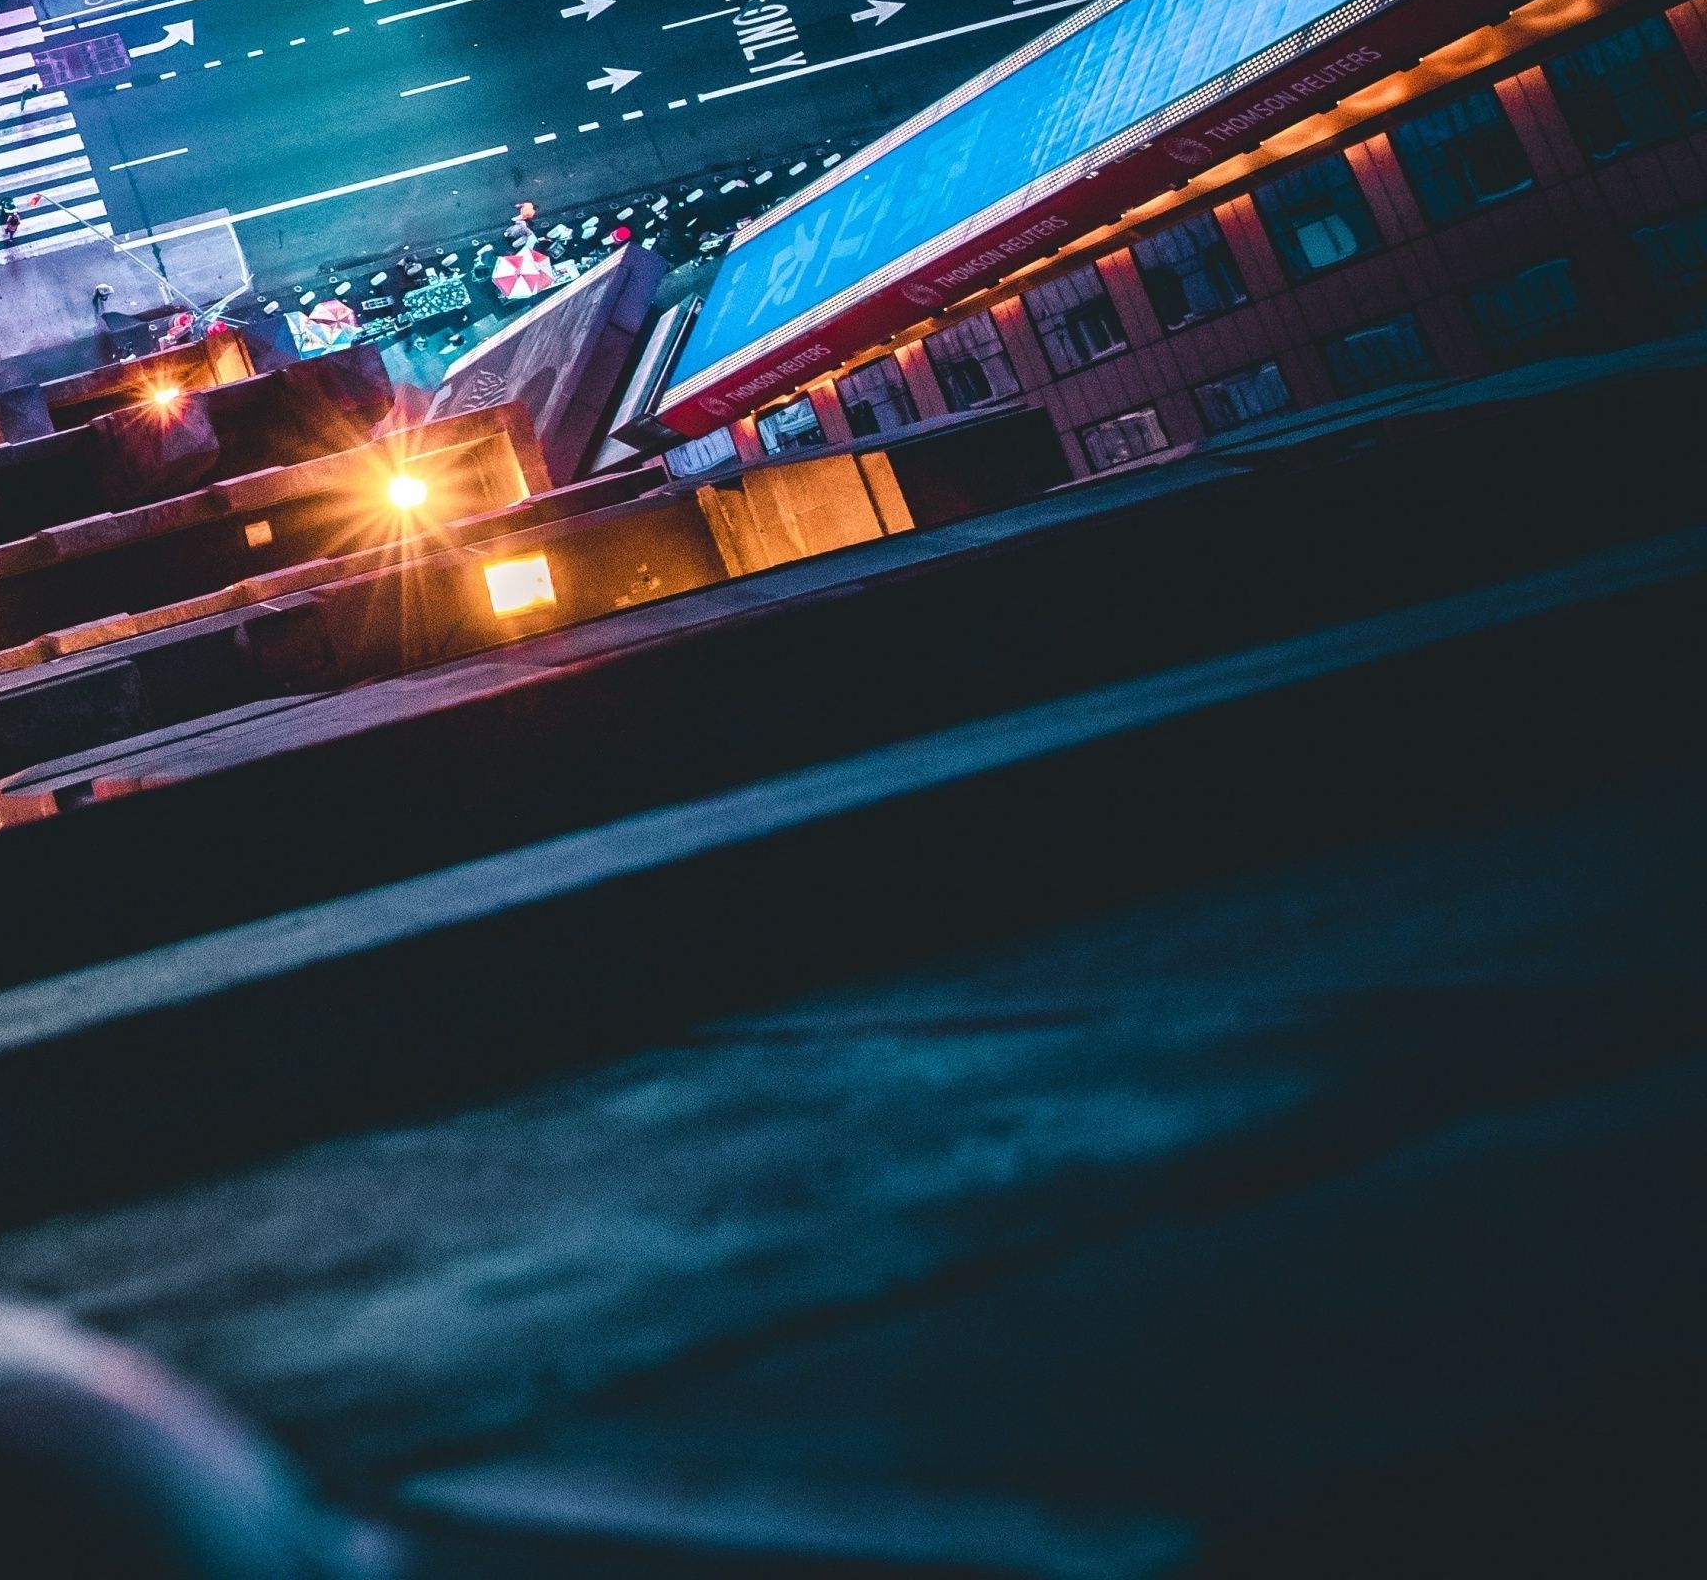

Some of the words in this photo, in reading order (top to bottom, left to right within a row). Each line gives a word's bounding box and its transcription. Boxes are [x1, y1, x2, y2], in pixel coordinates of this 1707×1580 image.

[732, 4, 807, 74] ONLY
[1204, 89, 1299, 140] THOMSON
[1292, 46, 1383, 96] REUTERS
[933, 249, 1007, 288] THOMSON
[998, 215, 1068, 254] REUTERS
[776, 343, 832, 376] REUTERS
